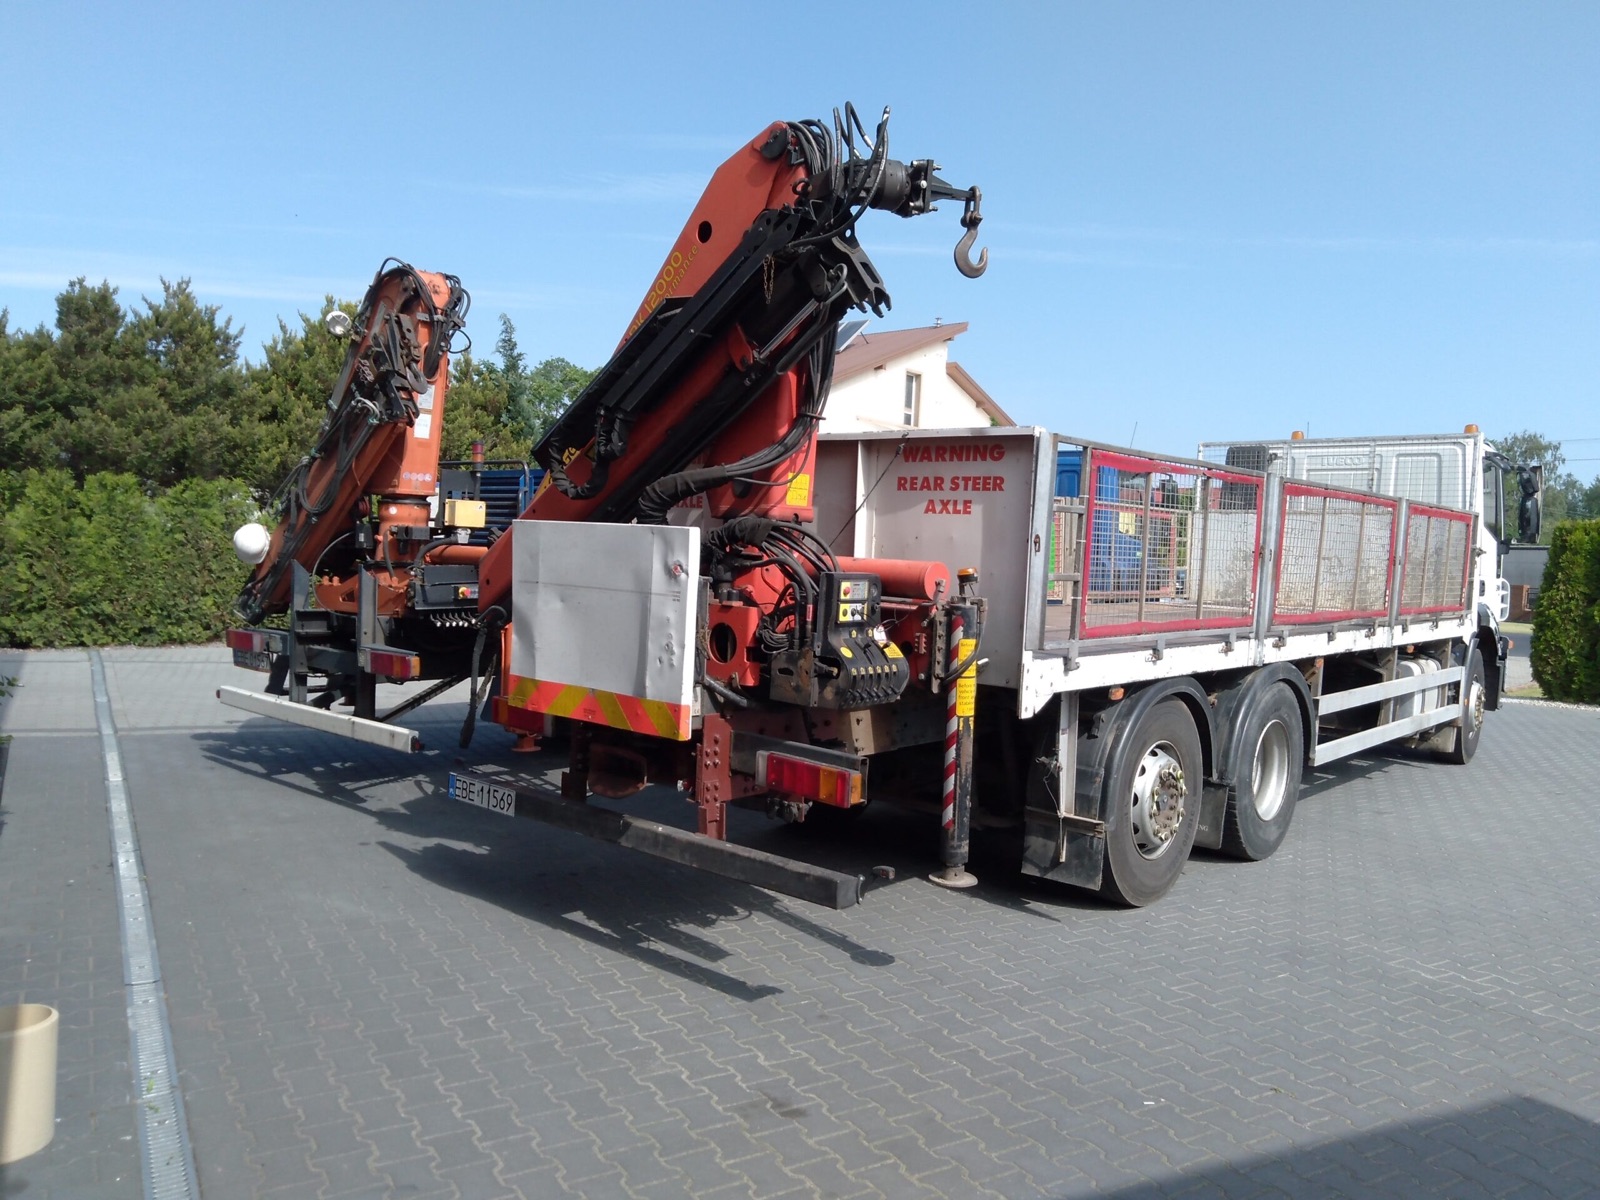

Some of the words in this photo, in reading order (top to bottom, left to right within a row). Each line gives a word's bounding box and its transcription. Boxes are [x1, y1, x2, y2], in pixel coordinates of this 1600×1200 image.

[657, 245, 698, 299] ormance
[644, 251, 682, 314] 12000
[902, 443, 1006, 463] WARNING
[1320, 456, 1363, 467] IVECO
[897, 476, 945, 492] REAR
[949, 475, 1005, 492] STEER
[674, 495, 704, 509] XLE
[923, 498, 973, 515] AXLE
[455, 778, 476, 802] EBE
[480, 785, 513, 812] 11569
